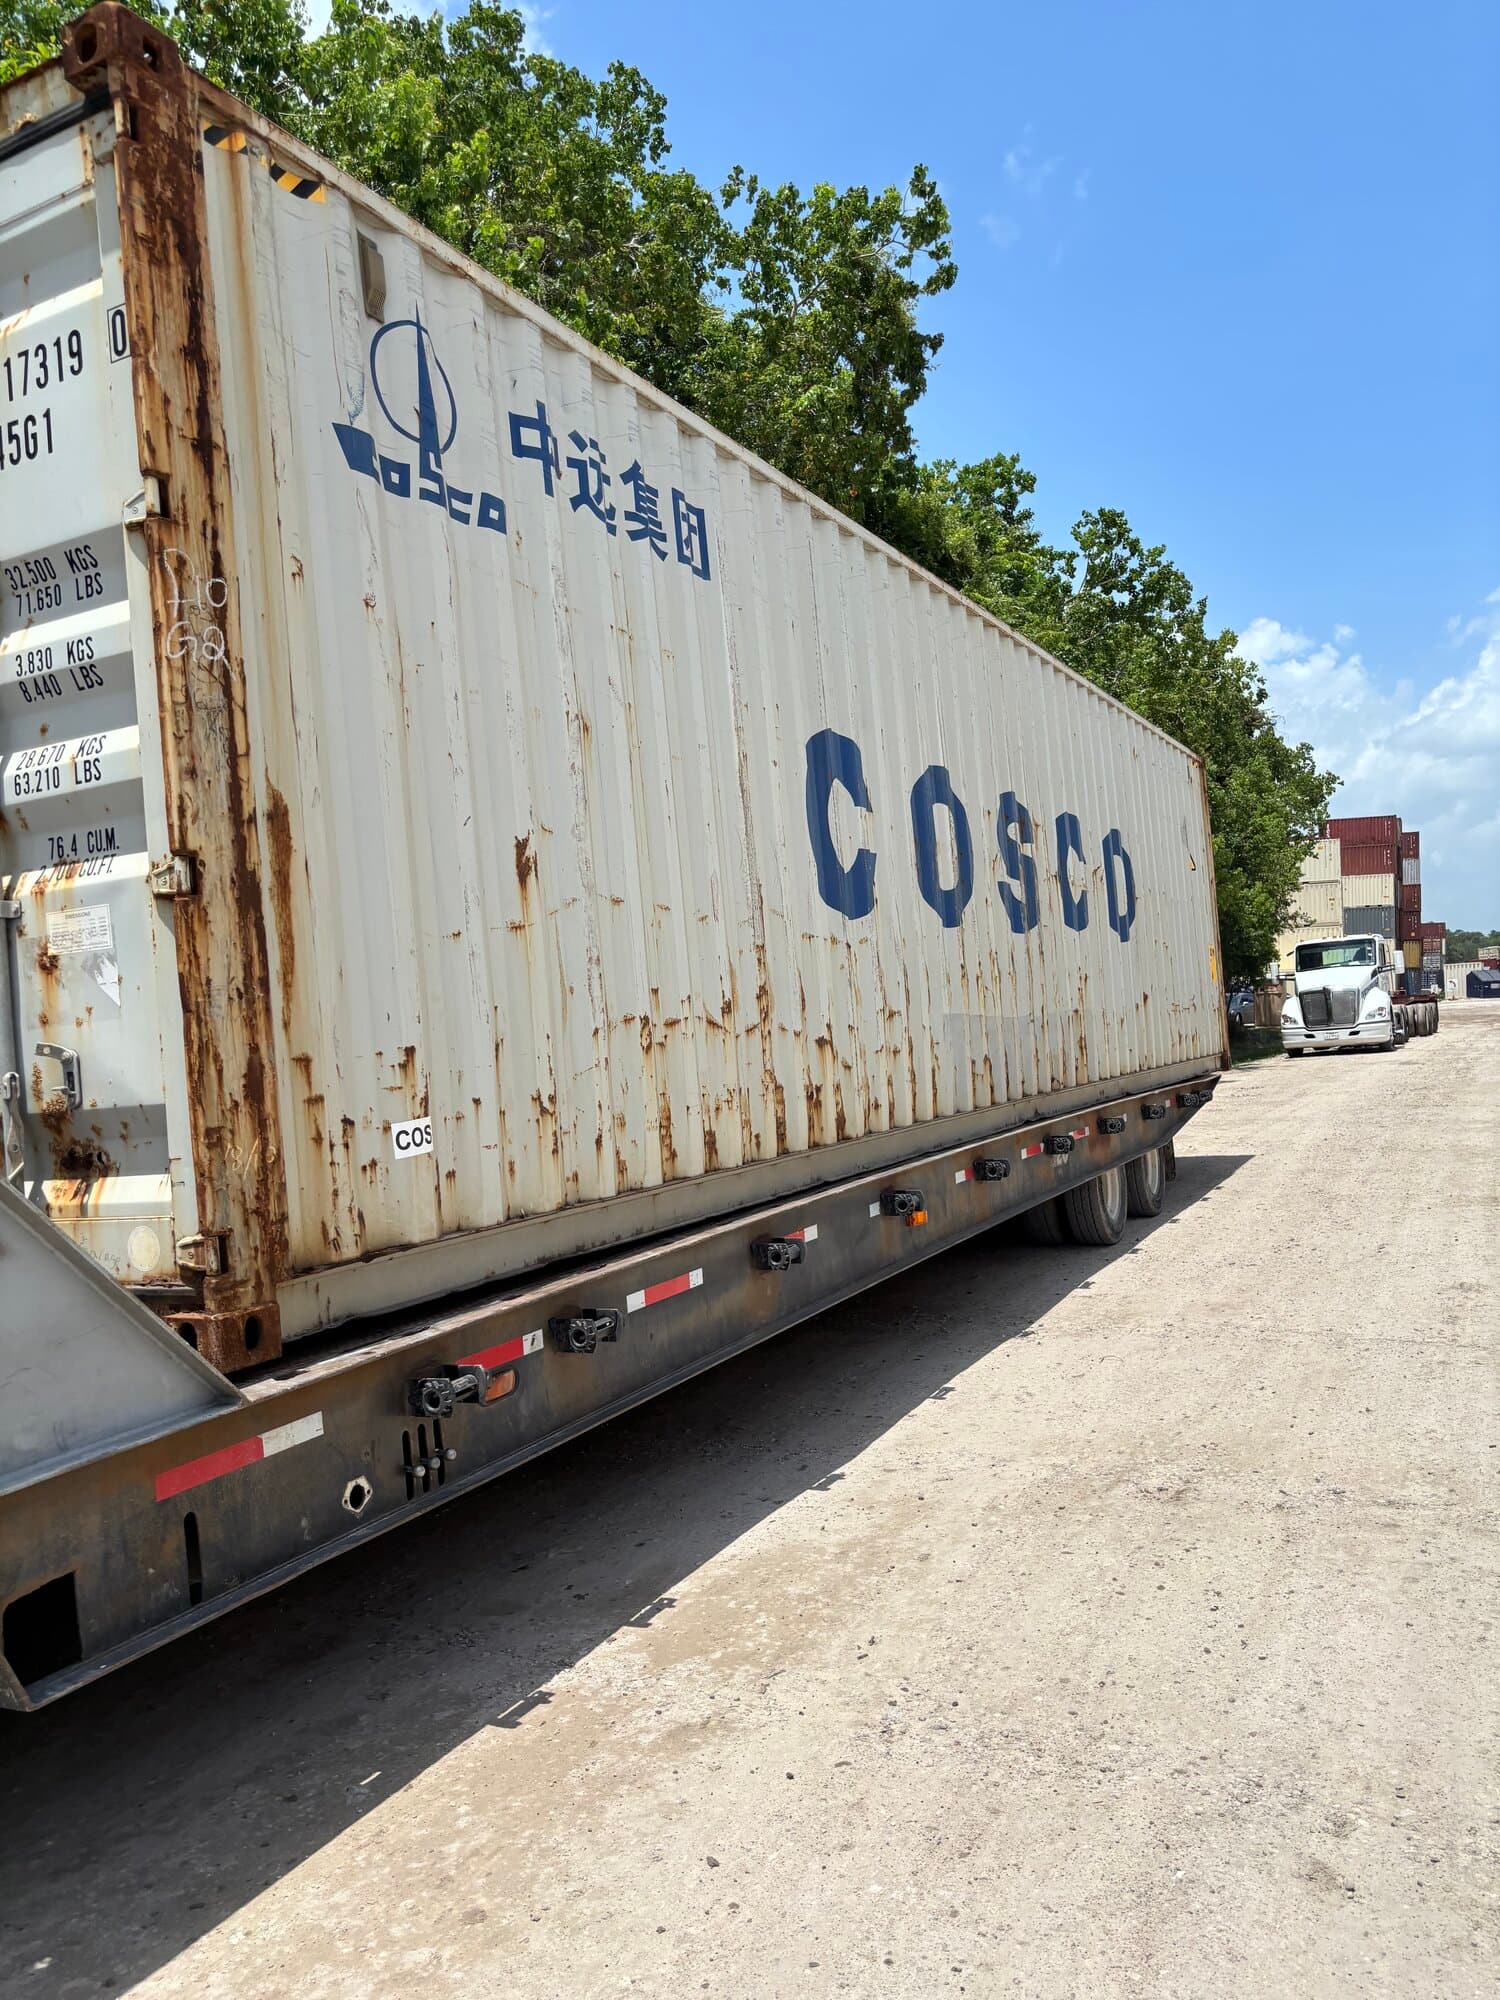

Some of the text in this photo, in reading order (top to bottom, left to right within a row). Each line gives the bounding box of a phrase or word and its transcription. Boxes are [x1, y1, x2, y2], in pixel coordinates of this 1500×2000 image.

[3, 309, 128, 402] 17319 0
[508, 399, 711, 581] 中远集团
[64, 544, 98, 574] KGS
[75, 572, 104, 601] LBS
[16, 636, 95, 677] 3,830 KGS
[69, 663, 104, 691] LBS
[75, 734, 107, 759] KGS
[14, 757, 102, 796] 63,210 LBS
[48, 833, 78, 860] 76.4
[805, 728, 1137, 943] COSCO
[395, 1124, 433, 1152] COS
